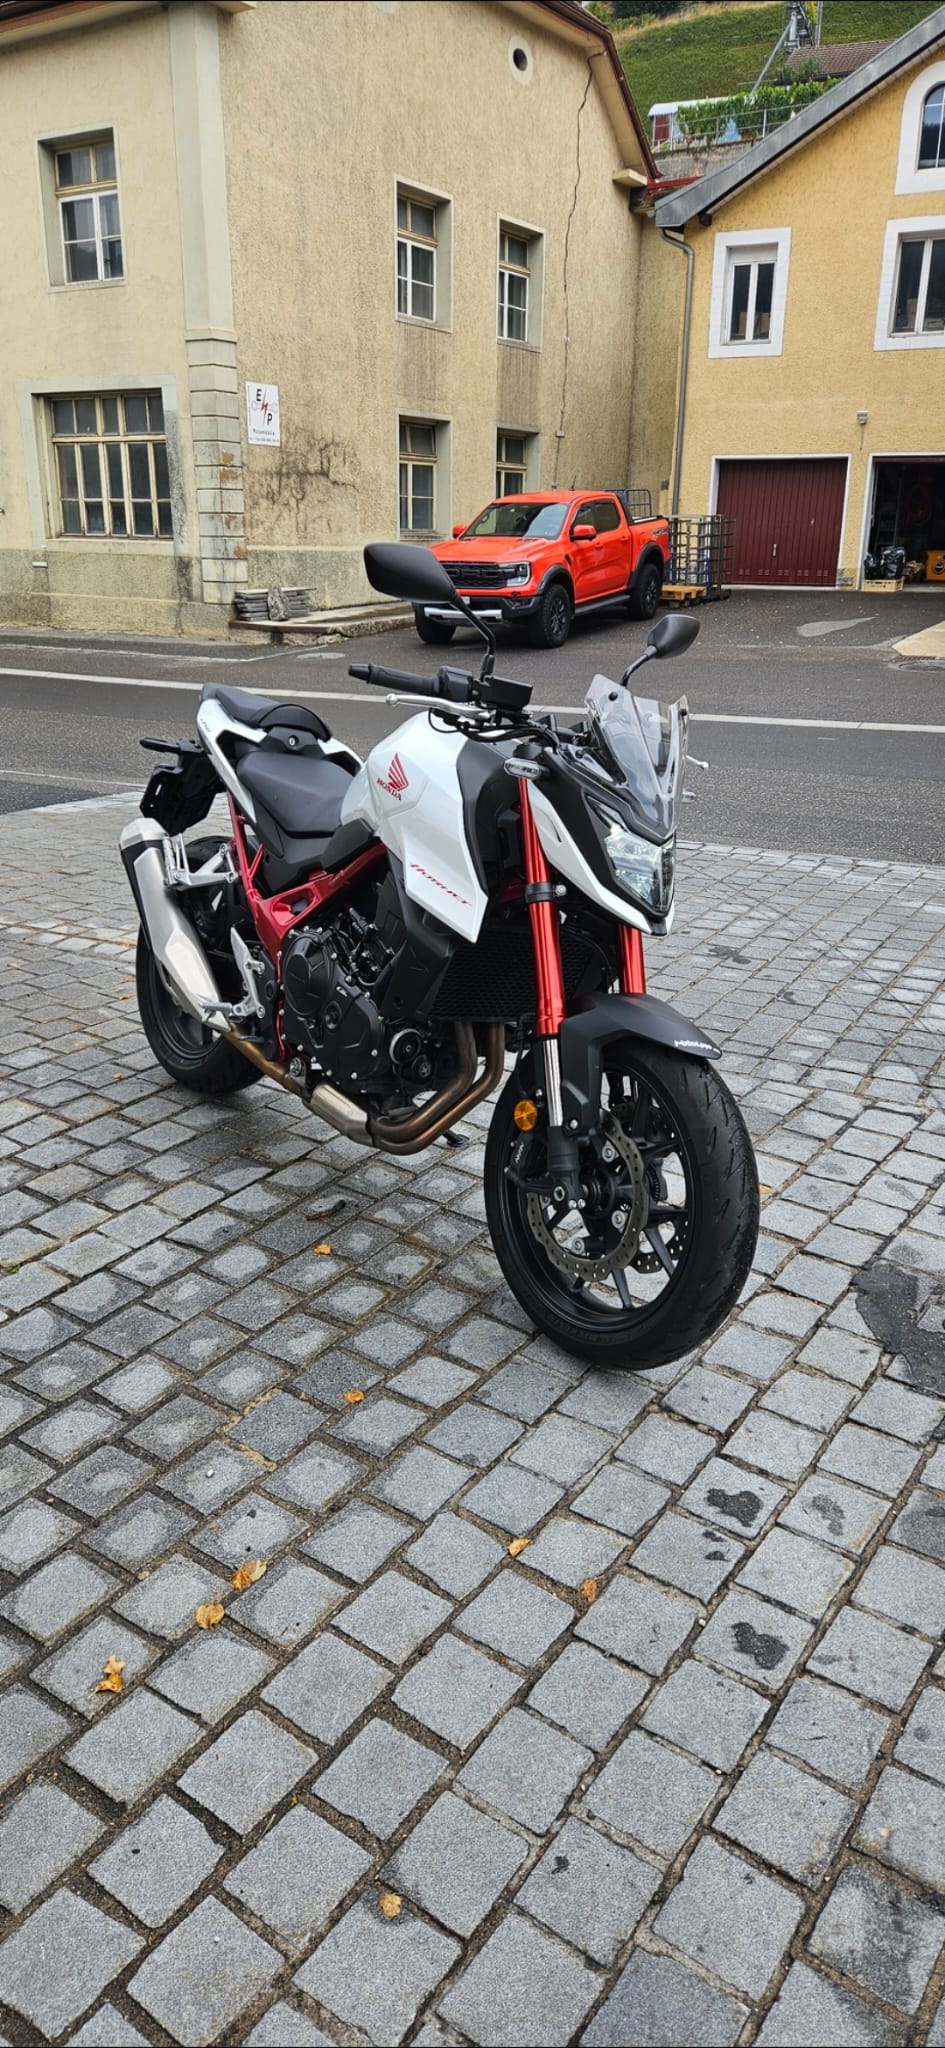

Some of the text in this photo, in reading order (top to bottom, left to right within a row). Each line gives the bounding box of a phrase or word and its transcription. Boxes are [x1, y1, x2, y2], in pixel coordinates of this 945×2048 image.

[256, 388, 262, 402] E
[267, 412, 273, 426] P
[376, 777, 402, 801] HONDA
